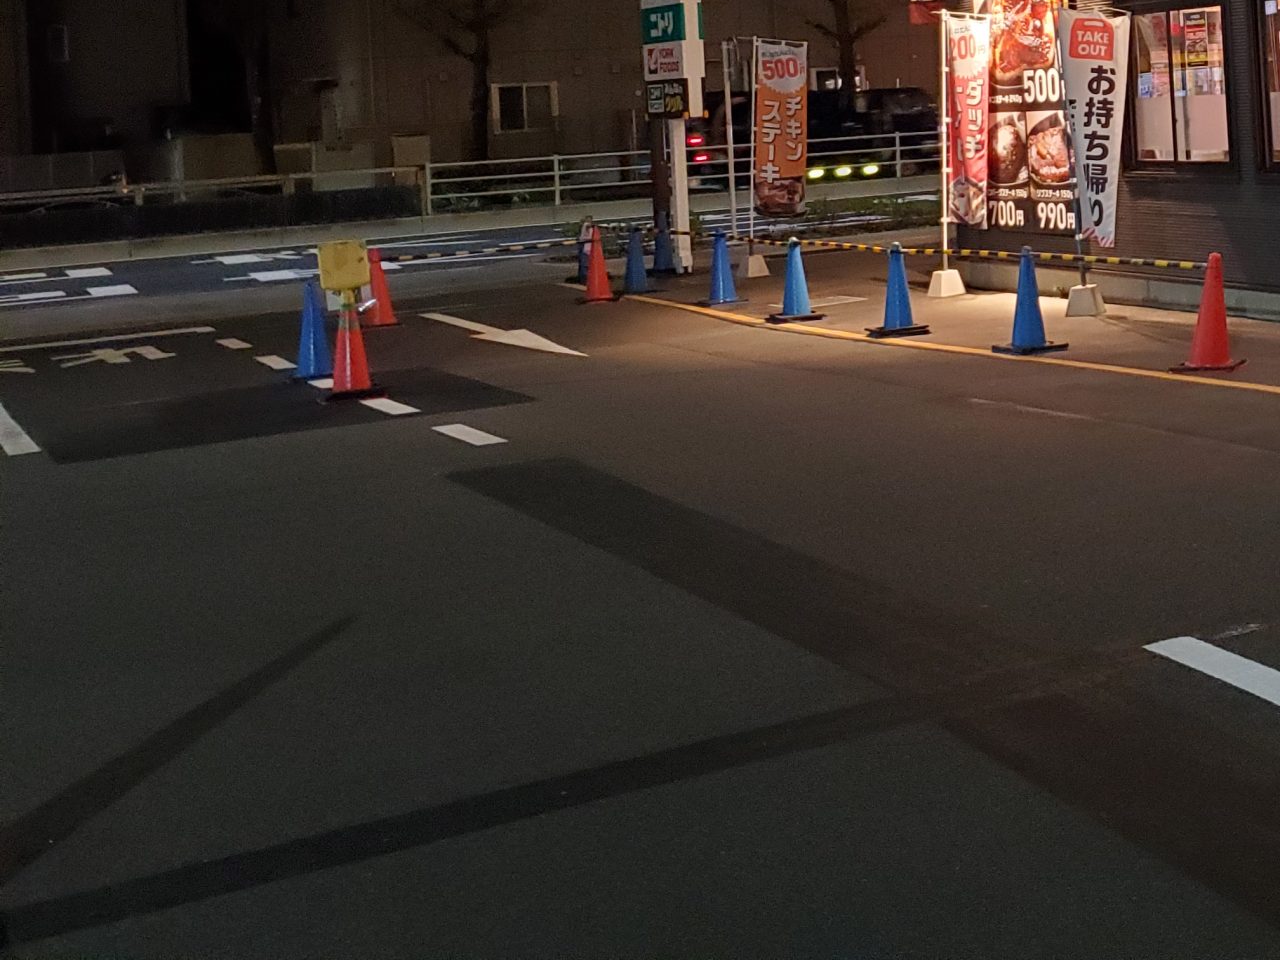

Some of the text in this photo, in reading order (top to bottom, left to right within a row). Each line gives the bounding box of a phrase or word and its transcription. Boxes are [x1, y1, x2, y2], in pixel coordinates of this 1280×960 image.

[650, 11, 673, 36] ニトリ
[1076, 30, 1110, 44] TAKE
[1077, 44, 1108, 56] OUT
[759, 100, 782, 183] ステーキ
[785, 96, 803, 161] チキン
[1083, 65, 1116, 227] お持ち帰り
[1037, 201, 1076, 230] 990円
